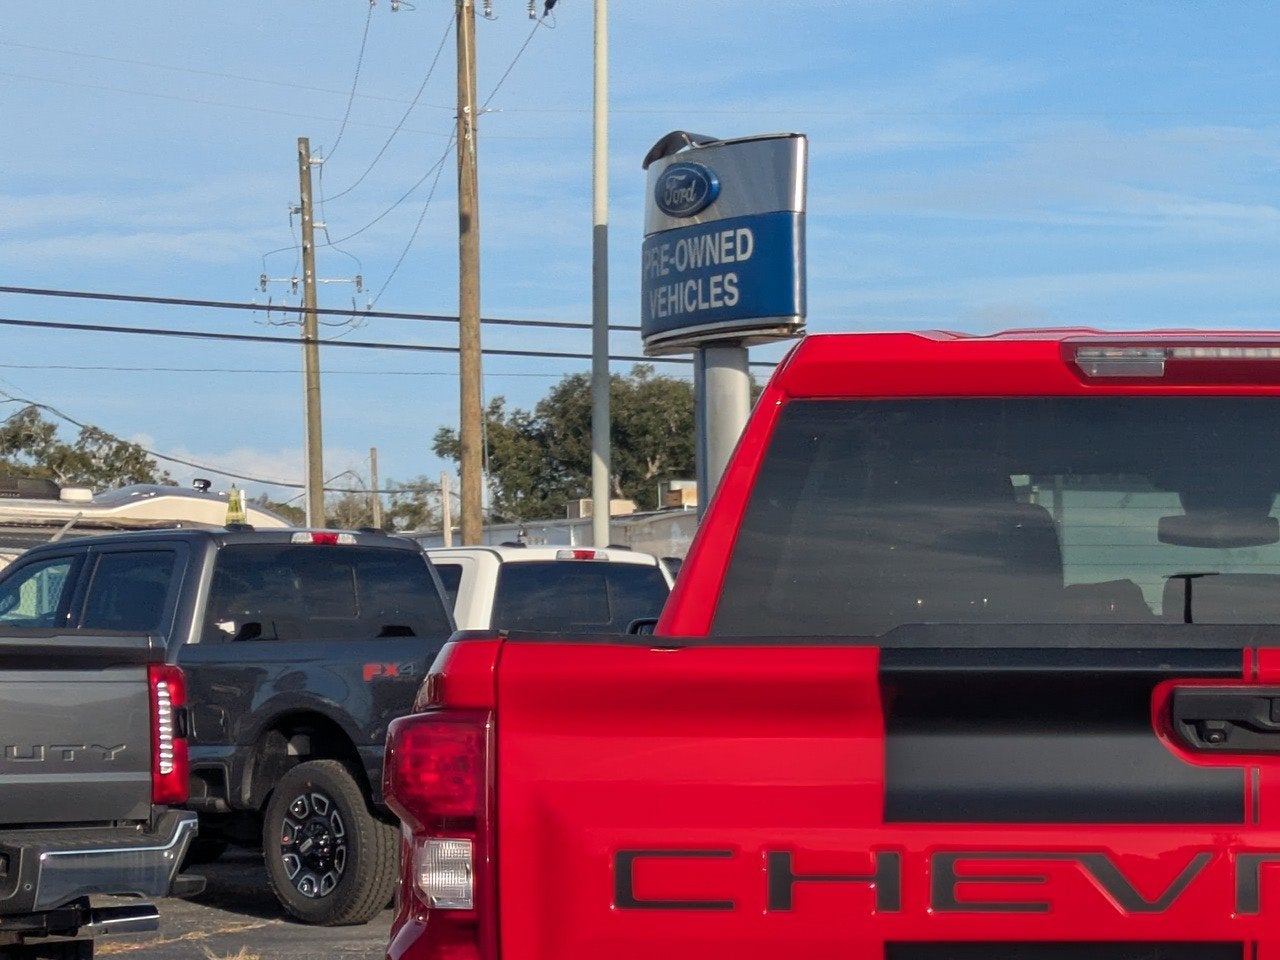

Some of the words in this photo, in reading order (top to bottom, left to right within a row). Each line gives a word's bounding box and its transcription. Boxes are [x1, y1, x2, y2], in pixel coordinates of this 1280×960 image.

[664, 174, 697, 206] Ford
[643, 227, 754, 279] PRE-OWNED
[650, 272, 739, 319] VEHICLES
[363, 662, 416, 682] FX4
